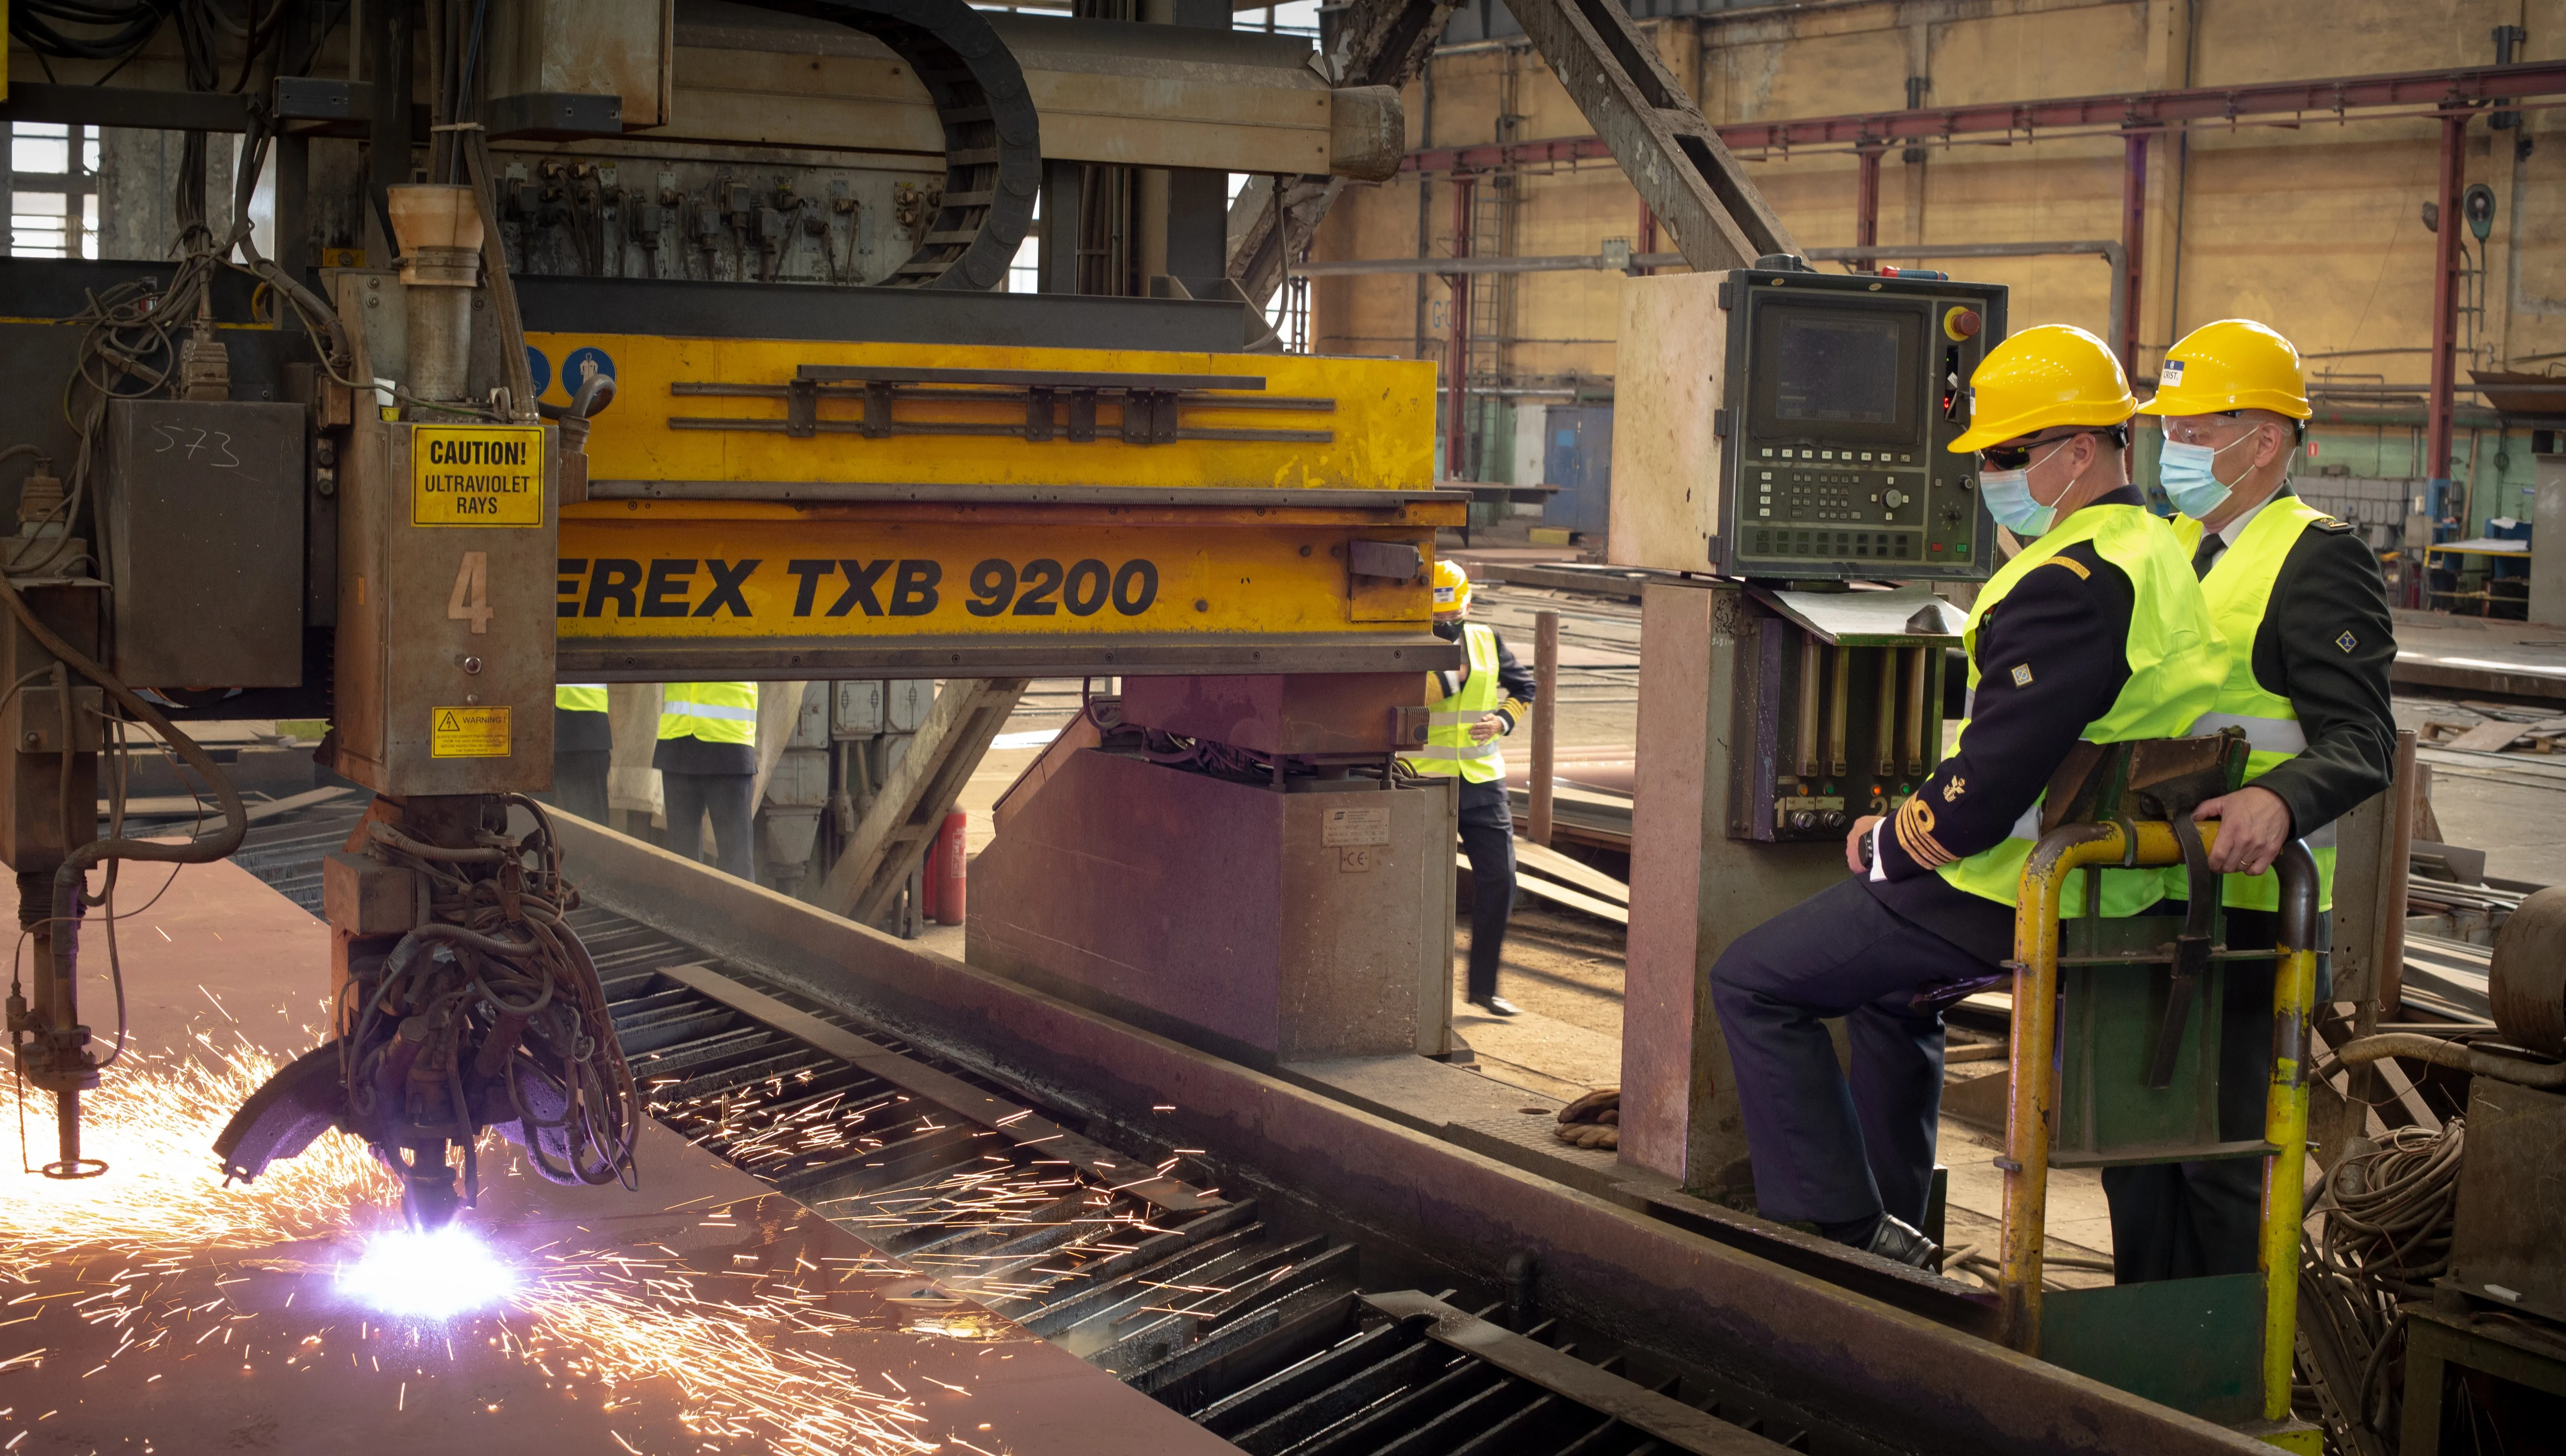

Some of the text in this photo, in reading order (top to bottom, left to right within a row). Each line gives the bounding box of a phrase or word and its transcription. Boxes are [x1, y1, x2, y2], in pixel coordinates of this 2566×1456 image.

[2164, 371, 2177, 379] CRIST
[151, 420, 240, 467] 573
[430, 440, 526, 465] CAUTION!
[425, 475, 530, 493] ULTRAVIOLET
[457, 497, 498, 514] RAYS
[448, 551, 494, 634] 4
[557, 558, 1159, 617] EREX TXB 9200
[1347, 852, 1364, 866] CE
